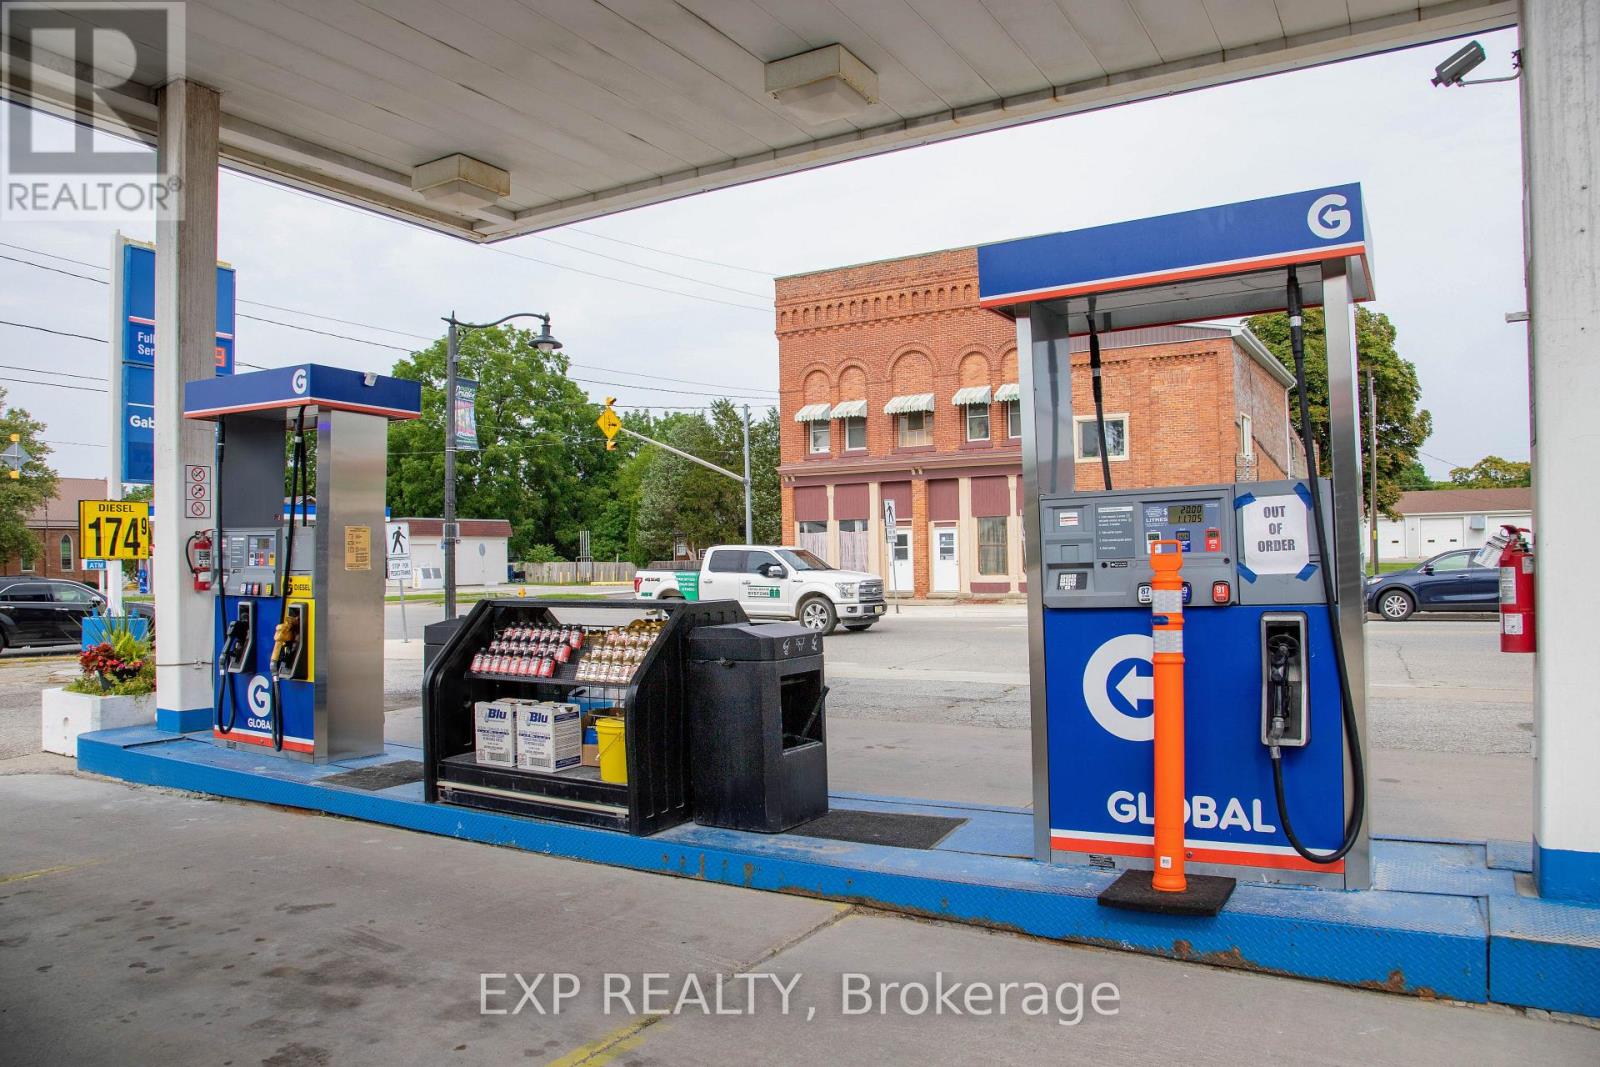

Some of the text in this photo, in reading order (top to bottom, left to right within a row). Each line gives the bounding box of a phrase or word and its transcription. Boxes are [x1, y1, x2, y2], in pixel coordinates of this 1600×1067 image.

[1307, 193, 1351, 239] G
[292, 369, 307, 394] G
[98, 504, 135, 512] DIESEL
[1263, 506, 1286, 518] OUT
[1268, 523, 1283, 534] OF
[1257, 539, 1296, 552] ORDER
[293, 584, 311, 592] DIESEL
[1140, 587, 1150, 595] 87
[1216, 585, 1226, 594] 91
[248, 675, 270, 717] G
[487, 708, 507, 720] Blu
[529, 711, 548, 723] Blu
[248, 718, 272, 730] GLOBA
[1107, 790, 1276, 833] GLBAL
